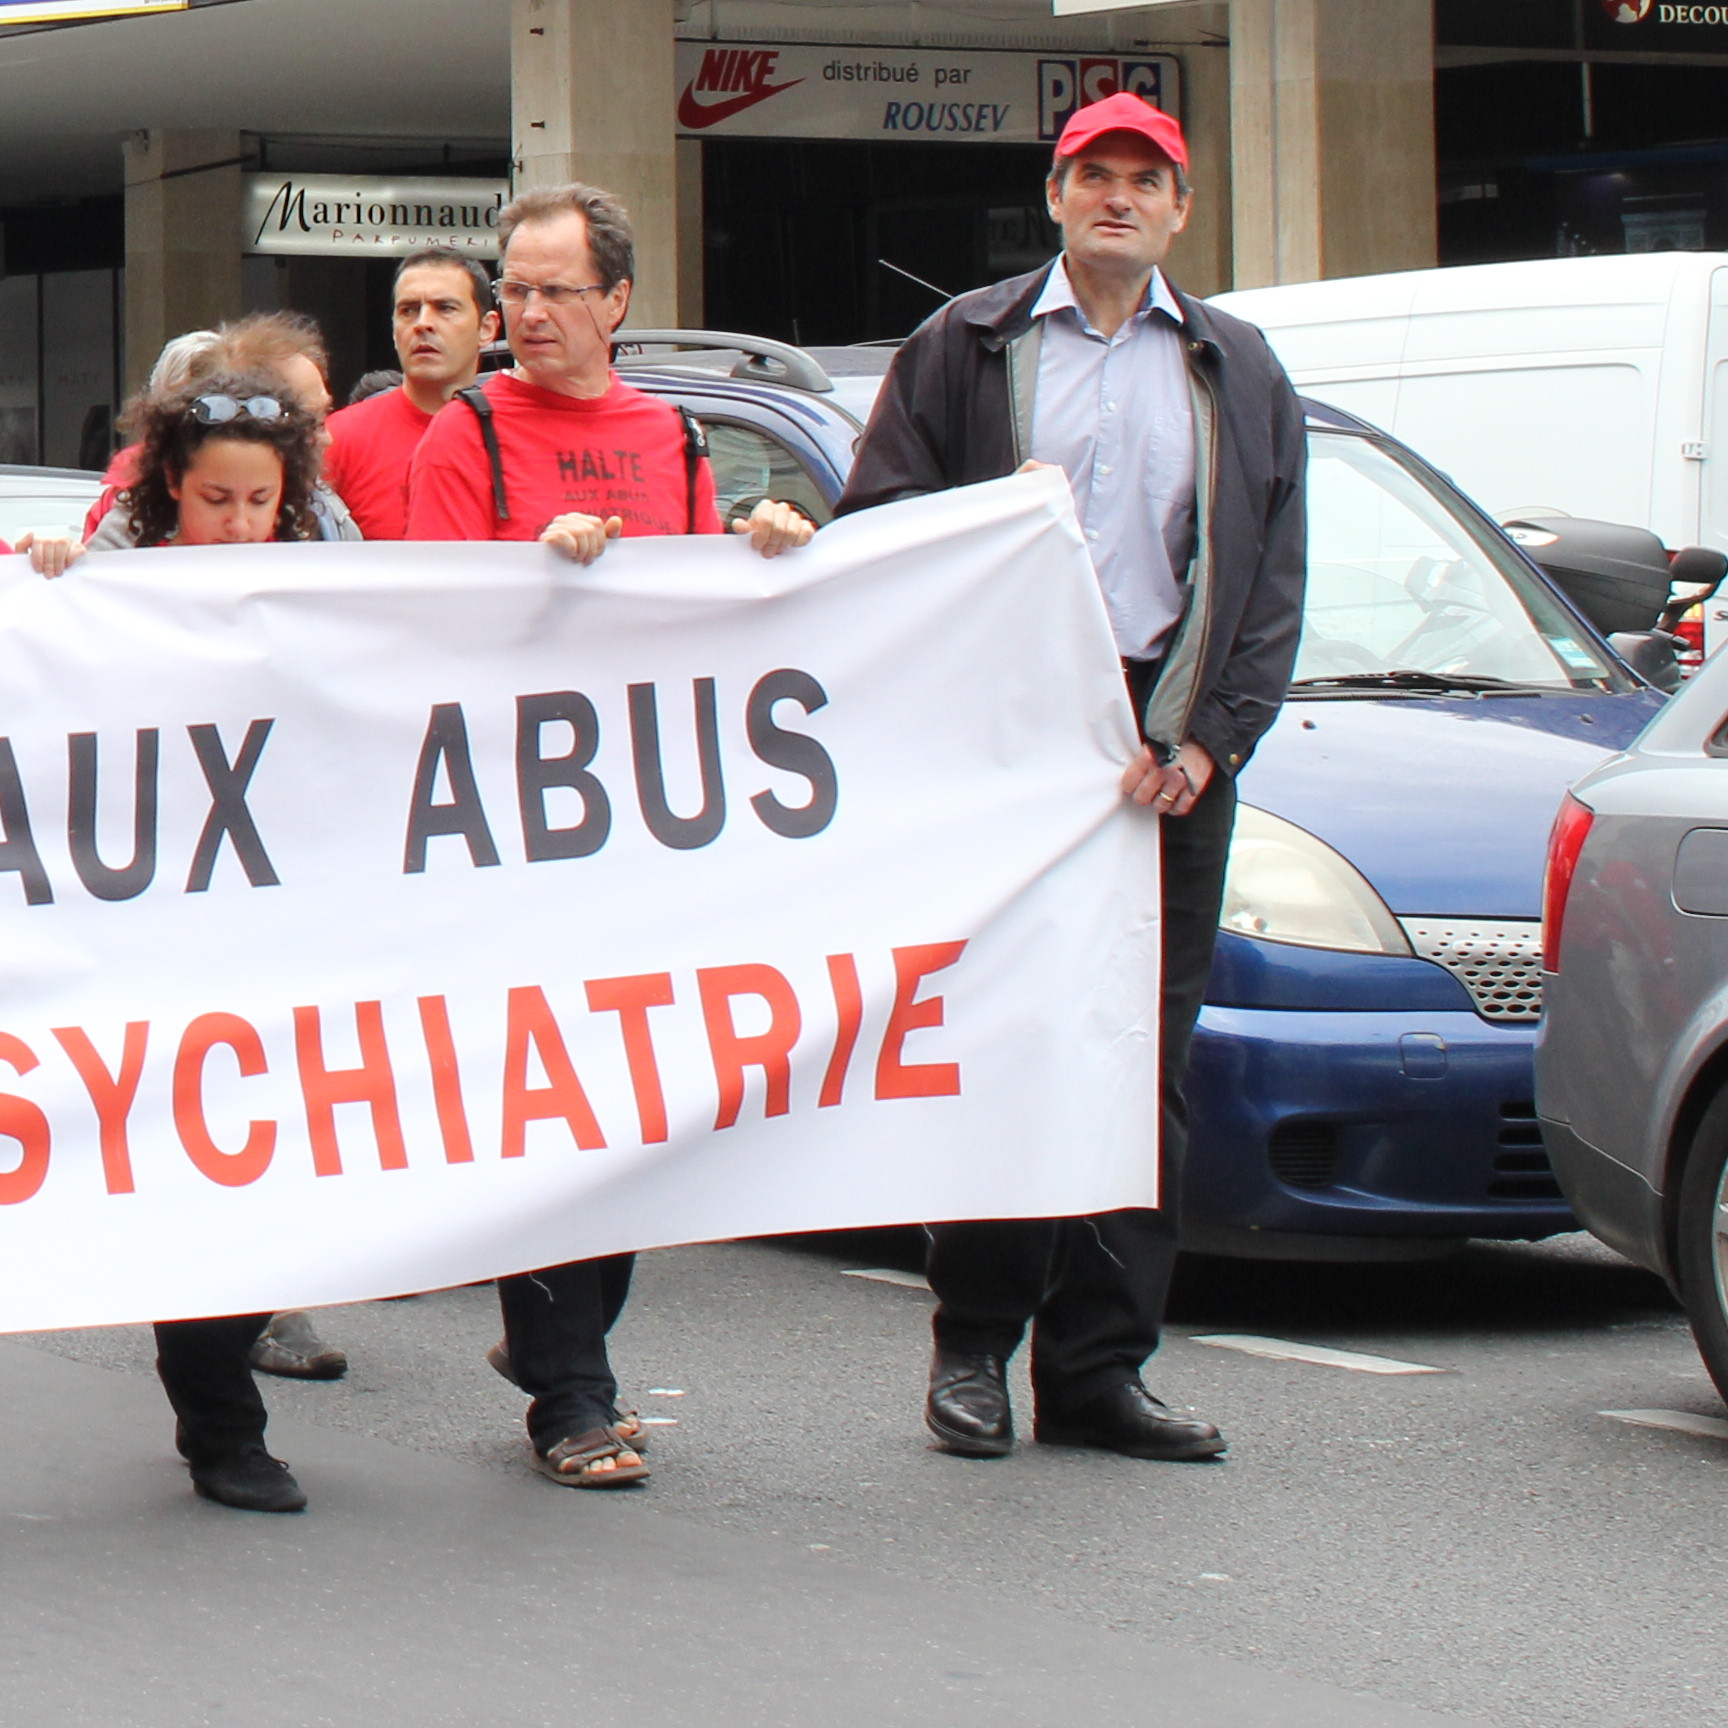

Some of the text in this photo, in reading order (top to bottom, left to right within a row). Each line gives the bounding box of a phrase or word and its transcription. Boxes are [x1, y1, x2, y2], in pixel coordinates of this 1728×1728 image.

[694, 48, 781, 93] NIKE
[821, 60, 971, 89] distribué par
[255, 180, 502, 246] Marionnaud
[332, 228, 489, 247] PARFUMERI
[555, 448, 644, 483] HALTE
[402, 667, 840, 875] ABUS
